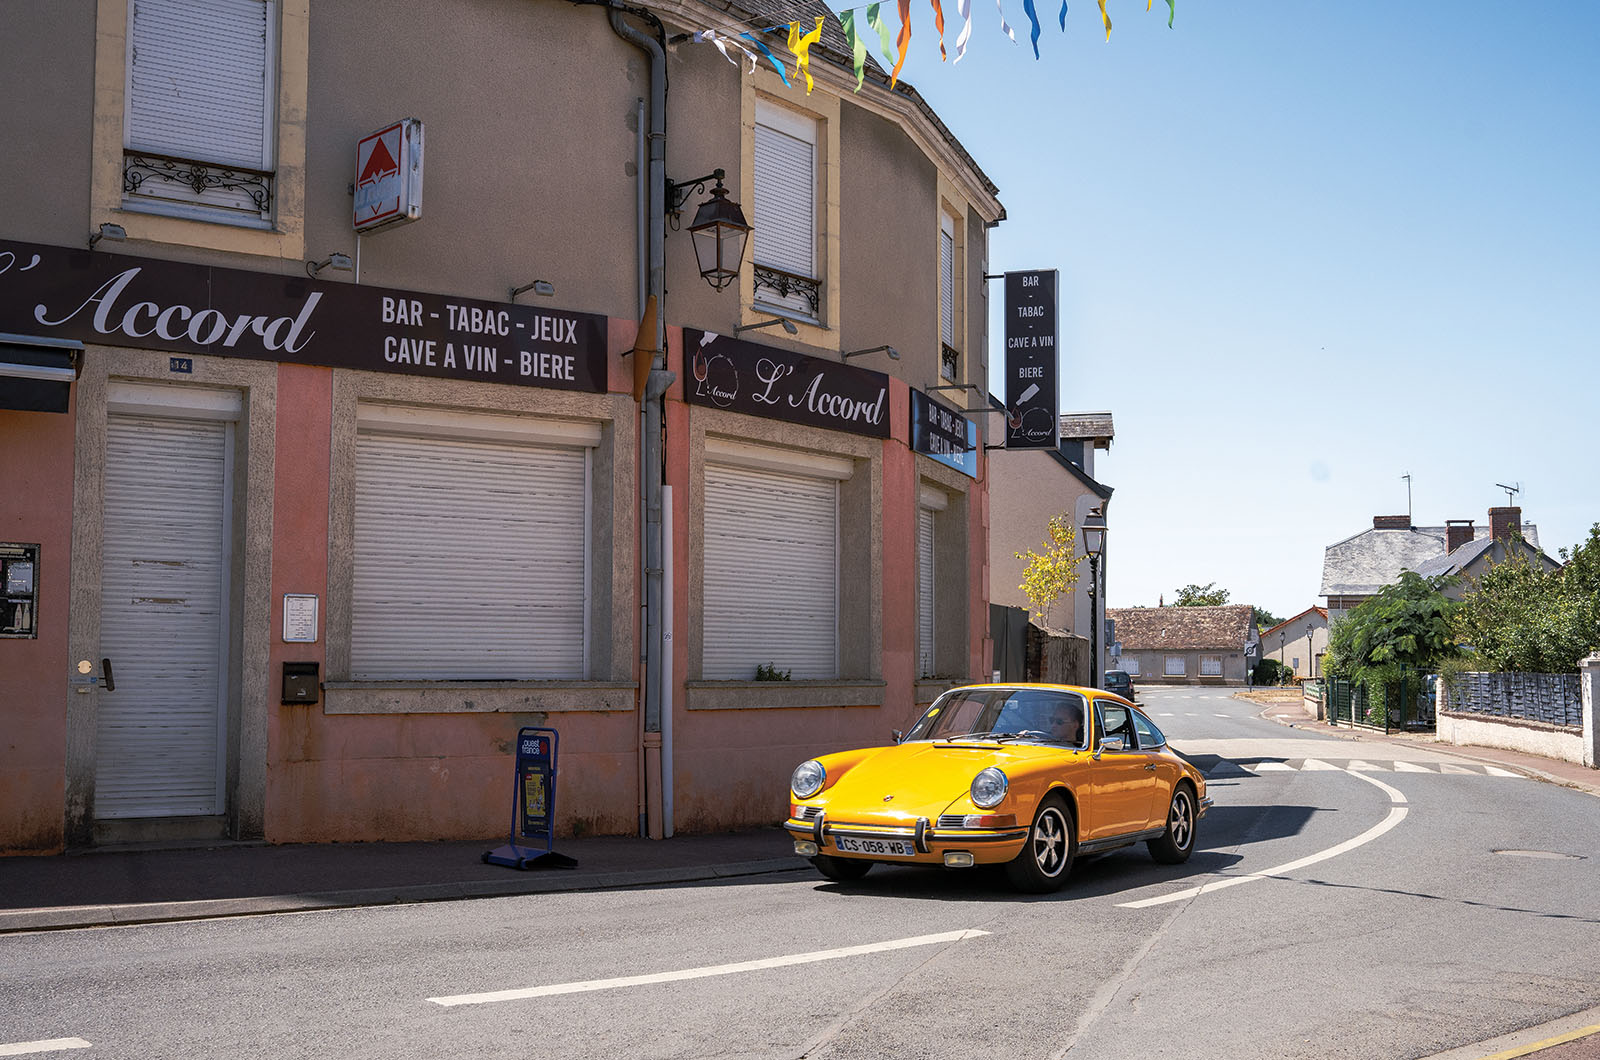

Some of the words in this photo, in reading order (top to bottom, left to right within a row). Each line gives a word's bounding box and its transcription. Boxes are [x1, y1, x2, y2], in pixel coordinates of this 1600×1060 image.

[1022, 275, 1039, 287] BAR
[0, 252, 323, 353] 'Accord
[1018, 306, 1044, 317] TABAC
[382, 297, 423, 327] BAR
[446, 304, 510, 336] TABAC
[531, 315, 578, 344] JEUX
[1008, 337, 1029, 348] CAVE
[1032, 336, 1037, 347] A
[1040, 336, 1054, 346] VIN
[384, 336, 437, 366] CAVE
[443, 343, 457, 368] A
[463, 345, 497, 373] VIN
[520, 351, 575, 381] BIERE
[1019, 366, 1044, 378] BIERE
[752, 358, 886, 425] L'Accord
[844, 840, 904, 854] CS-058-WB
